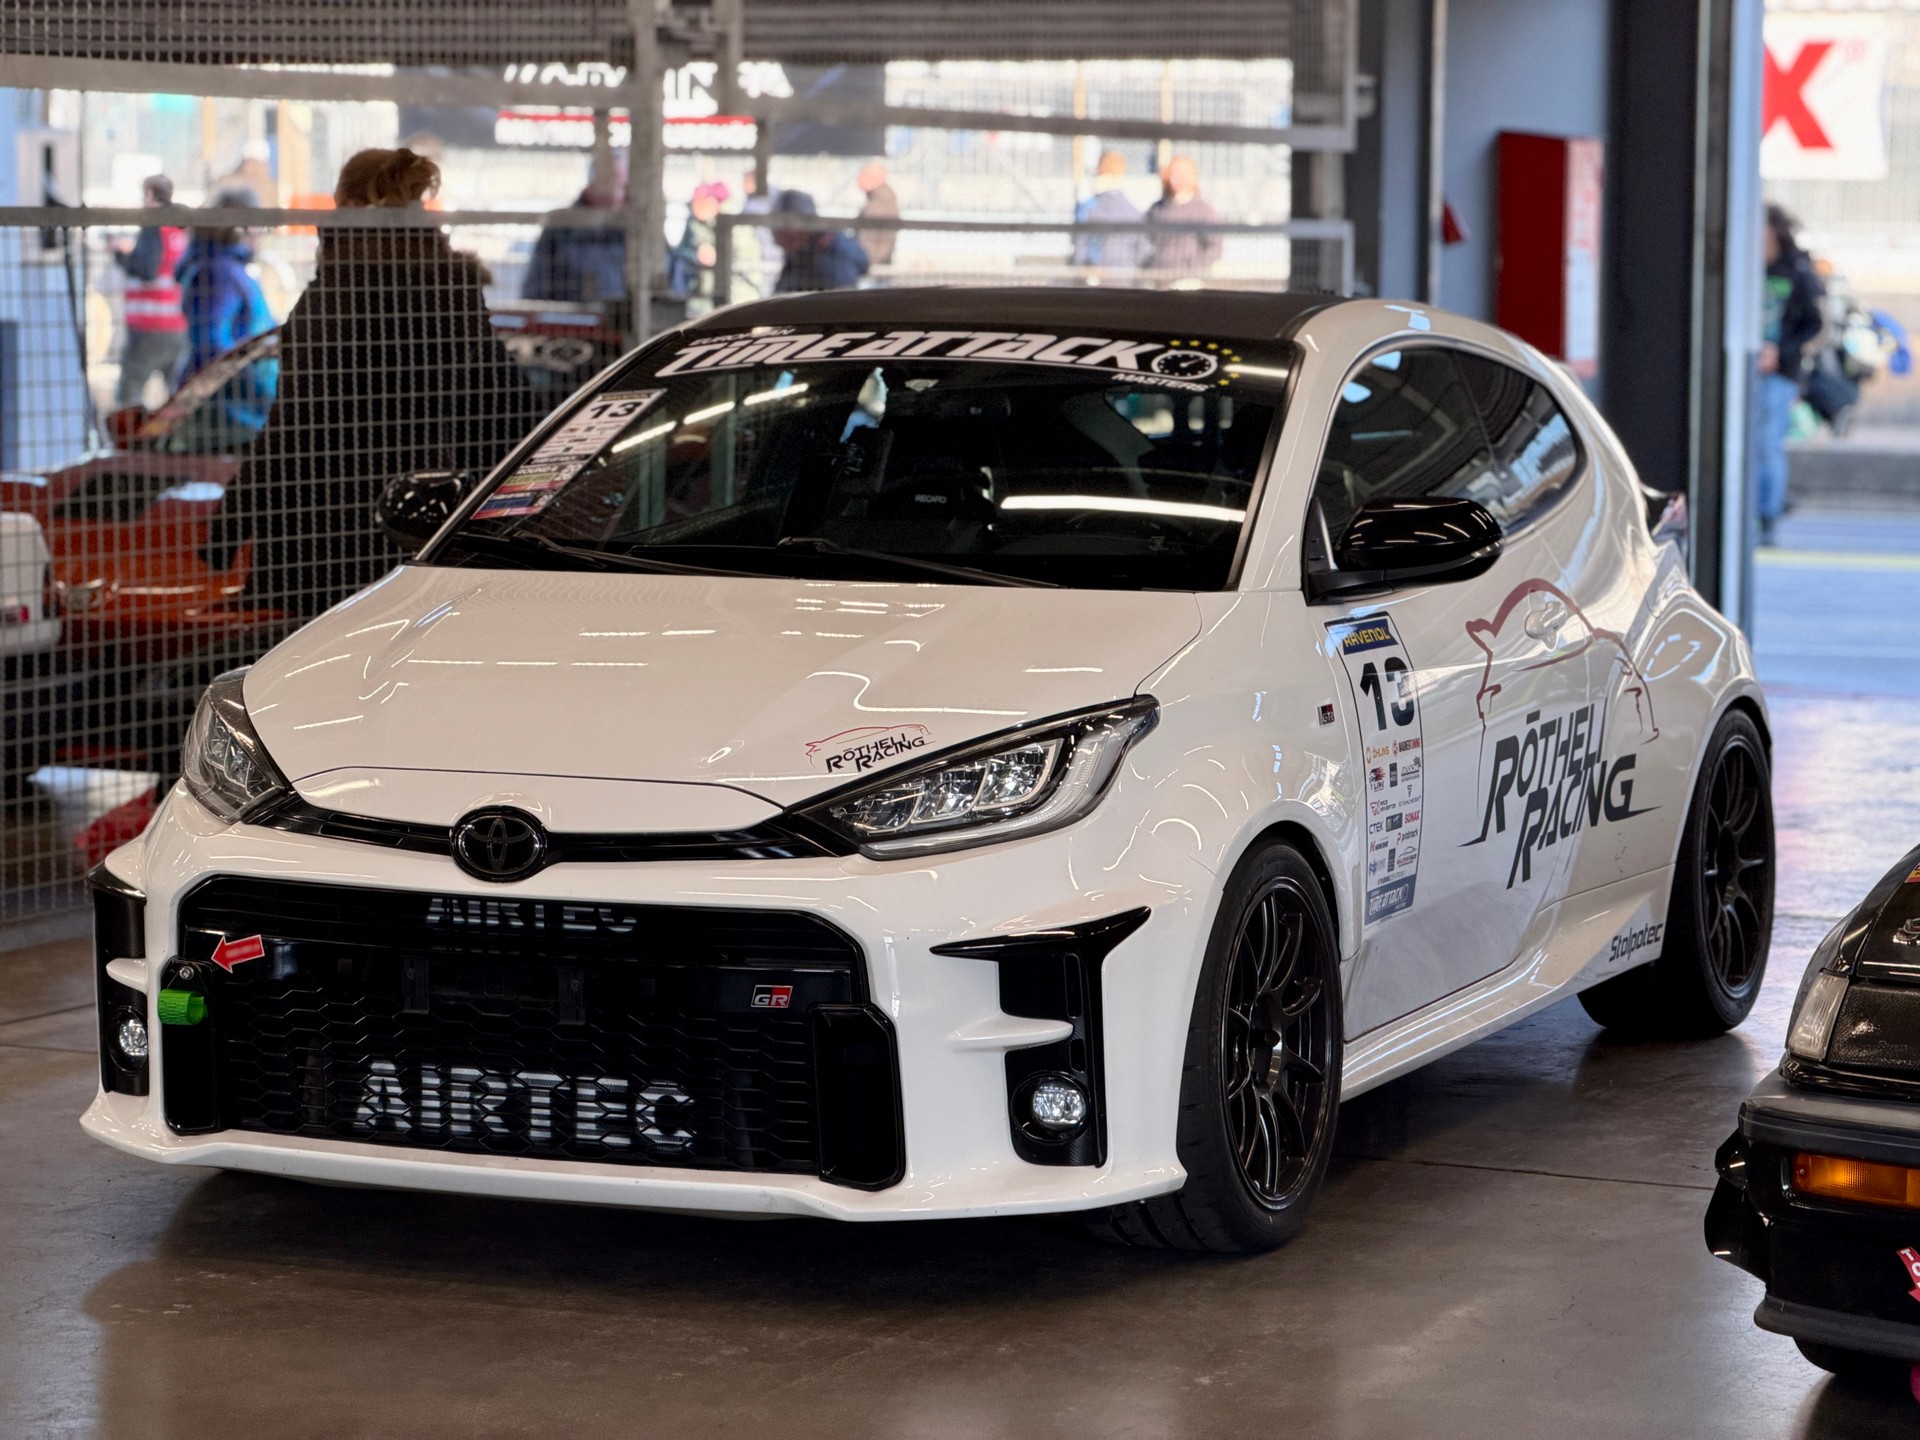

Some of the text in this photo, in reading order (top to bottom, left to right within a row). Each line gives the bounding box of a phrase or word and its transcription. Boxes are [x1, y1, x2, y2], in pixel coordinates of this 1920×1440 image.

[688, 327, 797, 346] EUROPAN
[1111, 373, 1209, 392] MASTERS
[588, 401, 644, 419] 13
[1343, 626, 1392, 648] RAVENOL
[1359, 656, 1416, 732] 13
[855, 736, 925, 773] RACING
[1506, 753, 1663, 890] RACING
[753, 994, 789, 1007] GR
[352, 1060, 697, 1151] AIRTEC
